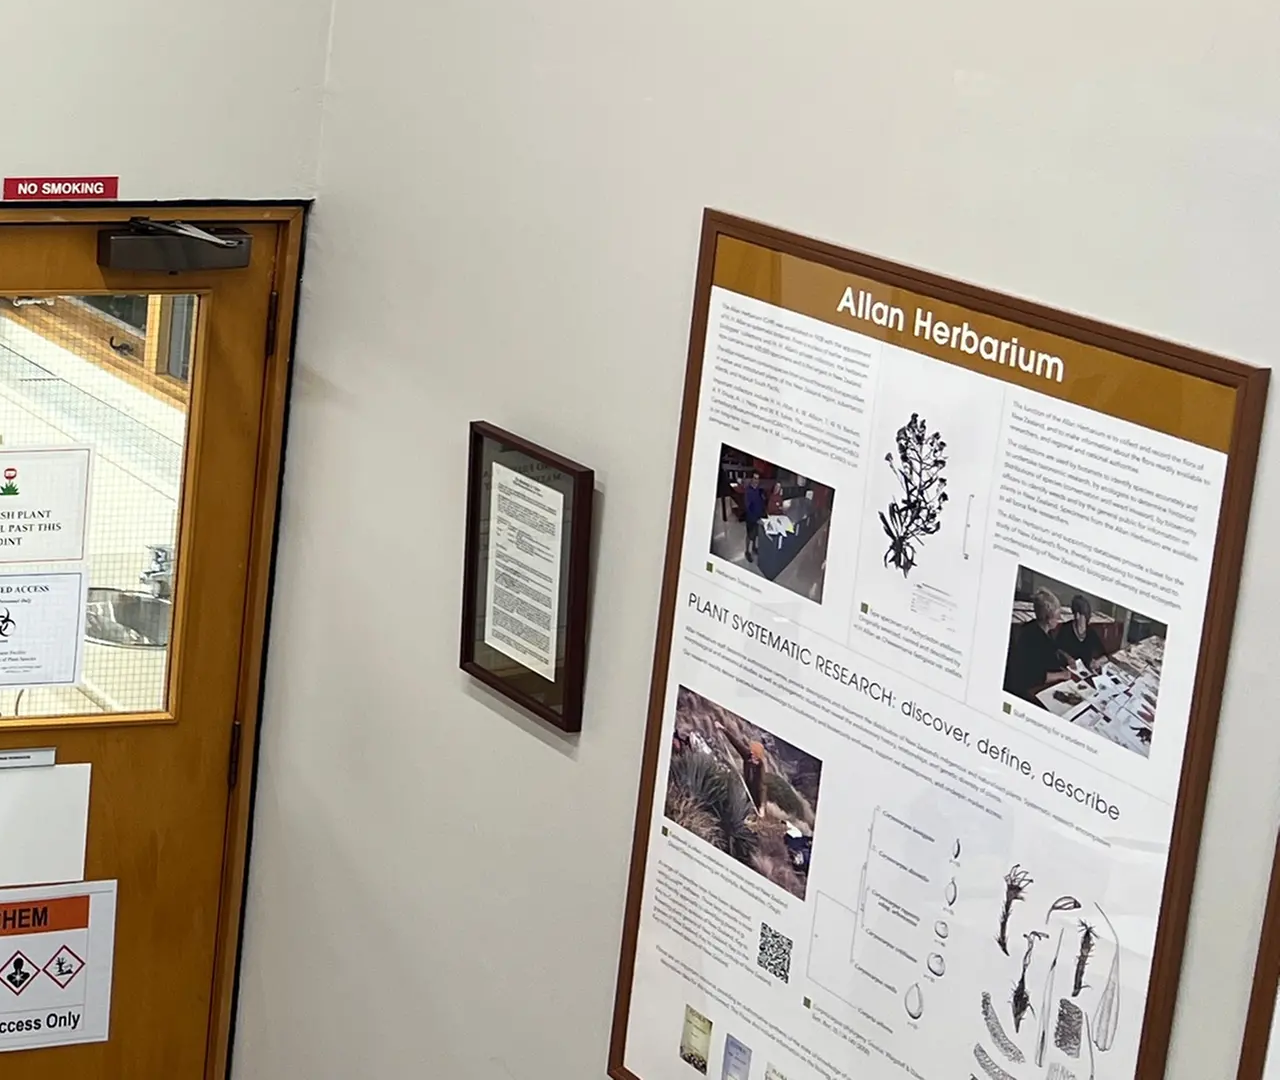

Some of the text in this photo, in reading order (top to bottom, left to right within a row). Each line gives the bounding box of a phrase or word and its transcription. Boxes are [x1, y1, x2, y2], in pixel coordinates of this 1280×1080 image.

[18, 182, 104, 195] NO SMOKING
[835, 286, 1065, 385] Allan Herbarium
[18, 510, 51, 519] PLANT
[9, 524, 34, 533] PAST
[38, 523, 61, 531] THIS
[15, 585, 49, 593] ACCESS
[688, 592, 729, 625] PLANT
[731, 612, 811, 667] SYSTEMATIC
[814, 654, 897, 709] RESEARCH:
[899, 696, 972, 749] discover,
[976, 733, 1037, 781] define,
[1040, 766, 1121, 823] describe
[46, 1011, 80, 1030] Only
